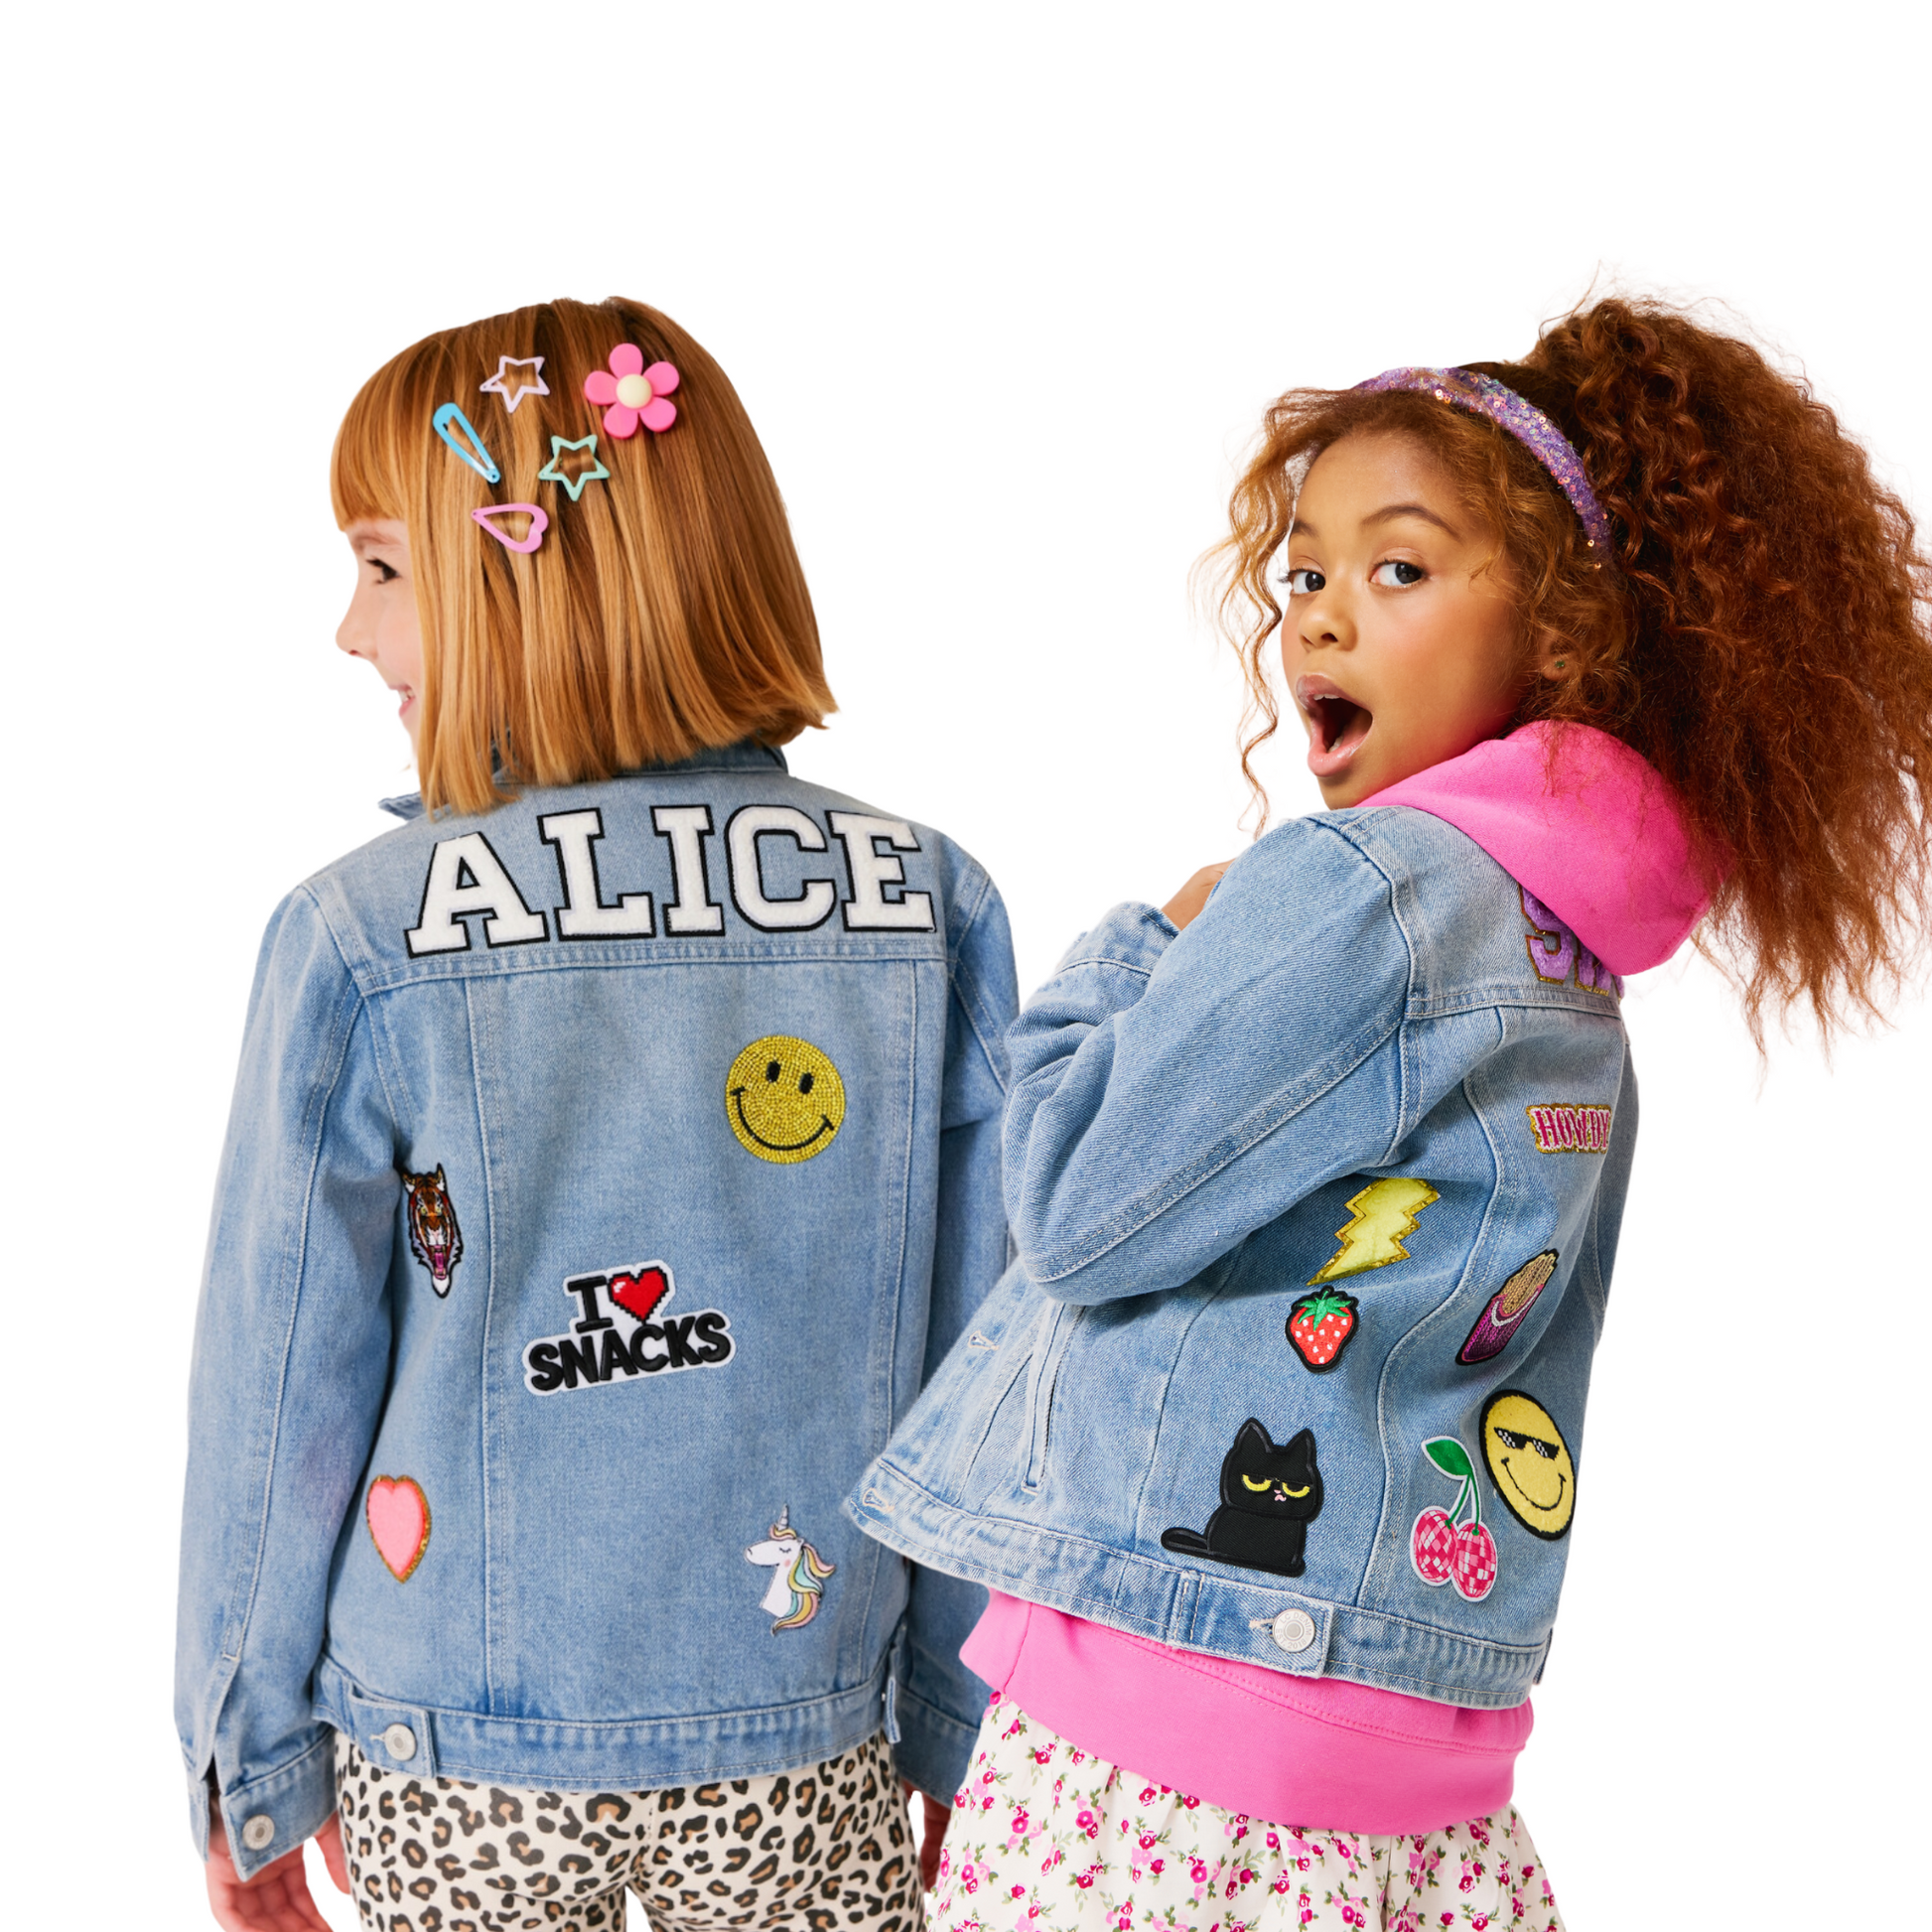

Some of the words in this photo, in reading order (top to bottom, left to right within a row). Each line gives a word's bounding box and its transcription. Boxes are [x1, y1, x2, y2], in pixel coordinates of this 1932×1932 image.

[404, 804, 936, 958] ALICE
[1529, 1107, 1610, 1150] HOWDY
[567, 1275, 614, 1333] I
[528, 1312, 732, 1391] SNACKS
[1276, 1628, 1287, 1647] EST.
[1288, 1638, 1308, 1649] 2018
[1280, 1612, 1291, 1624] LC
[1293, 1611, 1312, 1636] DENIM
